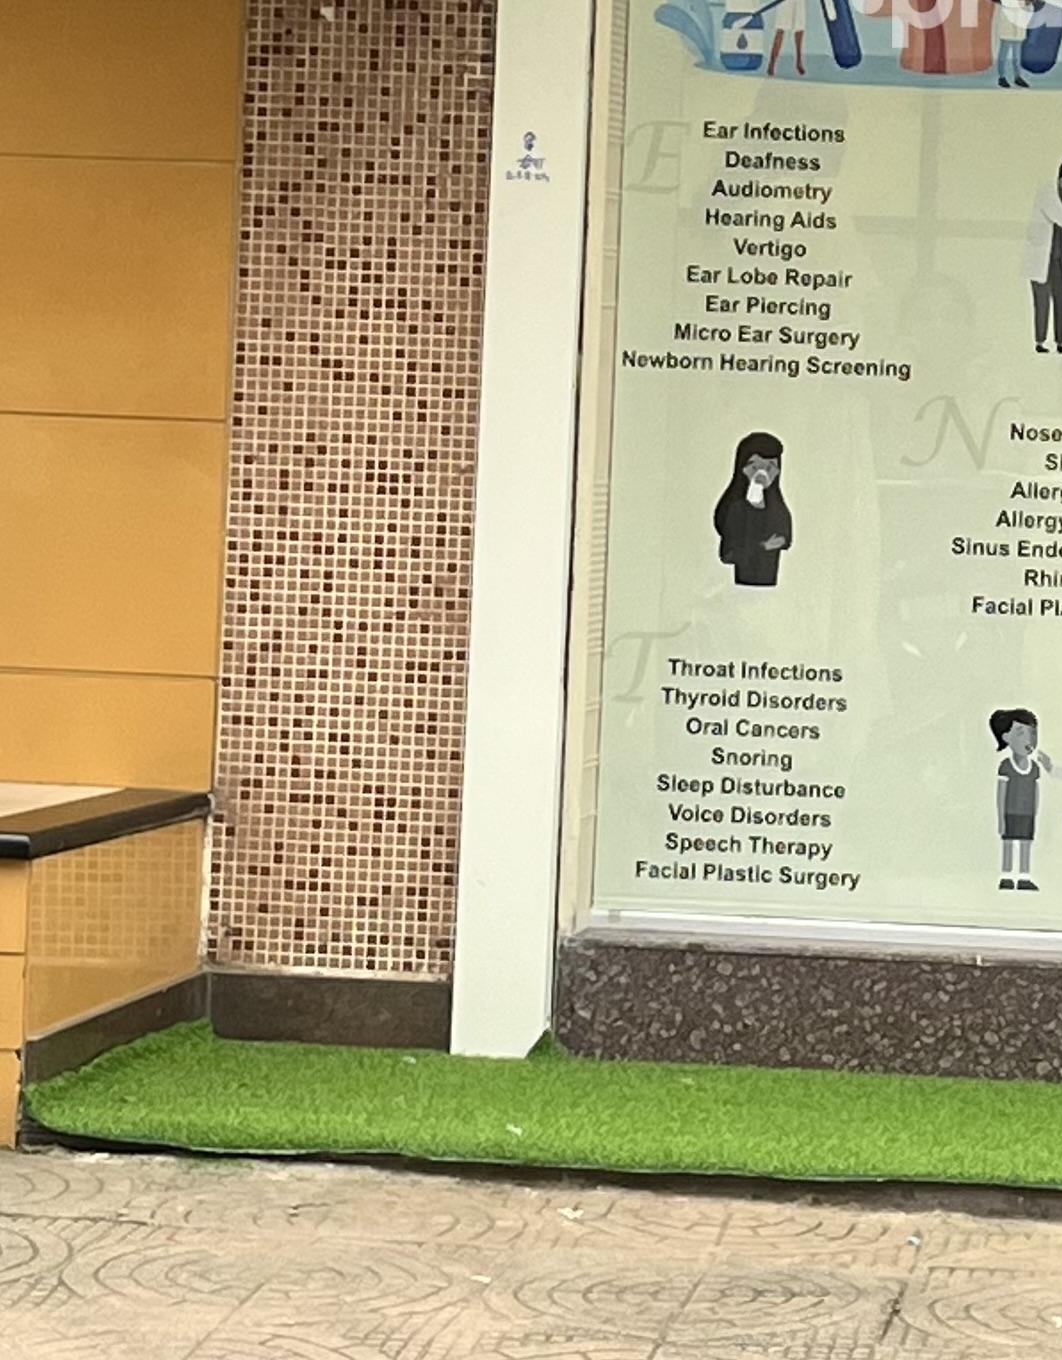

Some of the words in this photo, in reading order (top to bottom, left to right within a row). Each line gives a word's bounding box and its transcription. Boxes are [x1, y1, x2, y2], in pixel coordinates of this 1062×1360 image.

[704, 122, 737, 139] Ear
[744, 123, 845, 142] Infections
[725, 151, 820, 171] Deafness
[712, 180, 832, 204] Audiometry
[705, 209, 785, 231] Hearing
[790, 211, 836, 230] Aids
[734, 239, 807, 260] Vertigo
[686, 266, 721, 284] Ear
[727, 267, 778, 285] Lobe
[785, 269, 853, 290] Repair
[706, 296, 740, 313] Ear
[746, 297, 831, 320] Piercing
[674, 324, 731, 342] Micro
[738, 325, 772, 343] Ear
[779, 326, 860, 350] Surgery
[622, 351, 712, 370] Newborn
[720, 354, 800, 377] Hearing
[806, 357, 911, 380] Screening
[1010, 424, 1062, 442] Nose
[952, 538, 1010, 558] Sinus
[972, 597, 1033, 616] Facial
[668, 659, 735, 679] Throat
[741, 661, 843, 682] Infections
[661, 688, 740, 709] Thyroid
[746, 690, 847, 711] Disorders
[686, 718, 728, 735] Oral
[736, 720, 820, 739] Cancers
[711, 748, 792, 771] Snoring
[656, 775, 714, 797] Sleep
[720, 777, 846, 799] Disturbance
[668, 805, 724, 823] Voice
[730, 807, 831, 827] Disorders
[665, 833, 742, 854] Speech
[749, 837, 832, 860] Therapy
[635, 861, 696, 880] Facial
[703, 864, 772, 883] Plastic
[779, 866, 861, 891] Surgery
